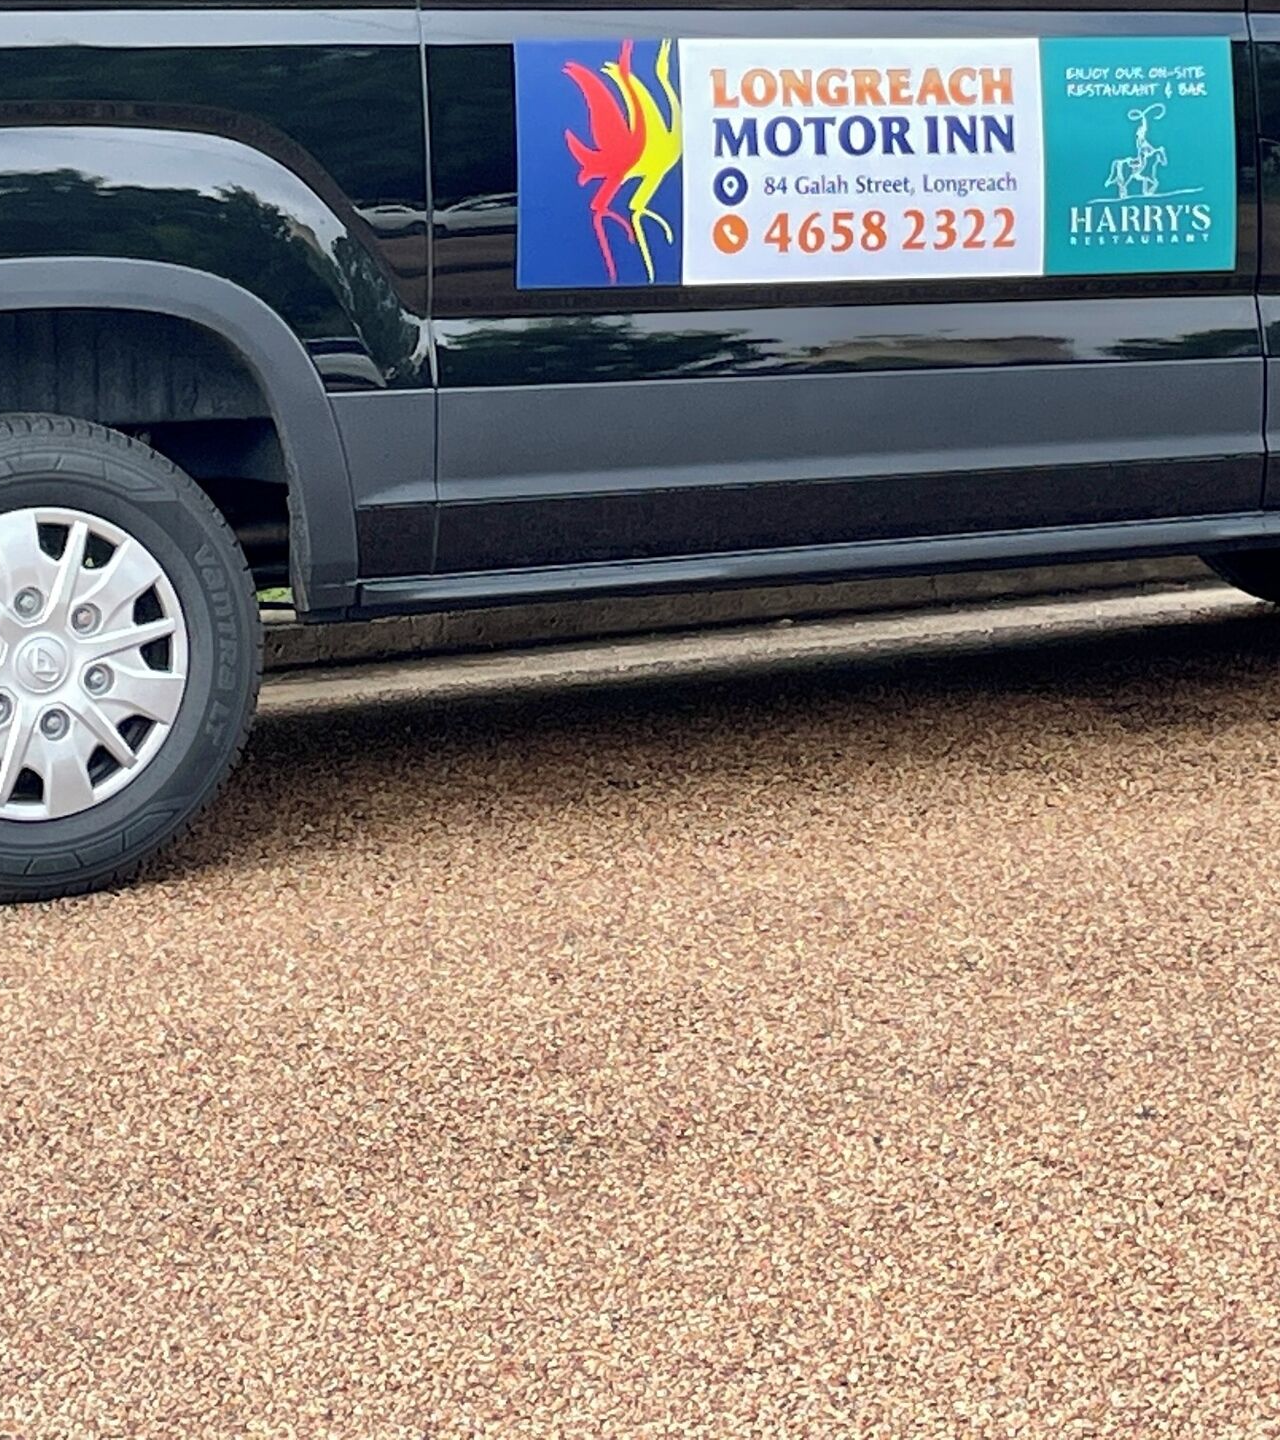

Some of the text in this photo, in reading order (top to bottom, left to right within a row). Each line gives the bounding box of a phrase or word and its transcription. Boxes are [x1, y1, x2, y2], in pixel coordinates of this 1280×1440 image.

[1065, 66, 1206, 81] ENJOY OUR ON-SITE
[709, 67, 1014, 108] LONGREACH
[1067, 81, 1208, 99] RESTAURANT & BAR
[712, 114, 1015, 157] MOTOR INN
[763, 172, 1018, 197] 84 Galah Street, Longreach
[764, 207, 1017, 253] 4658 2322
[1070, 204, 1211, 233] HARRY'S
[1070, 233, 1209, 246] RESTAURANT
